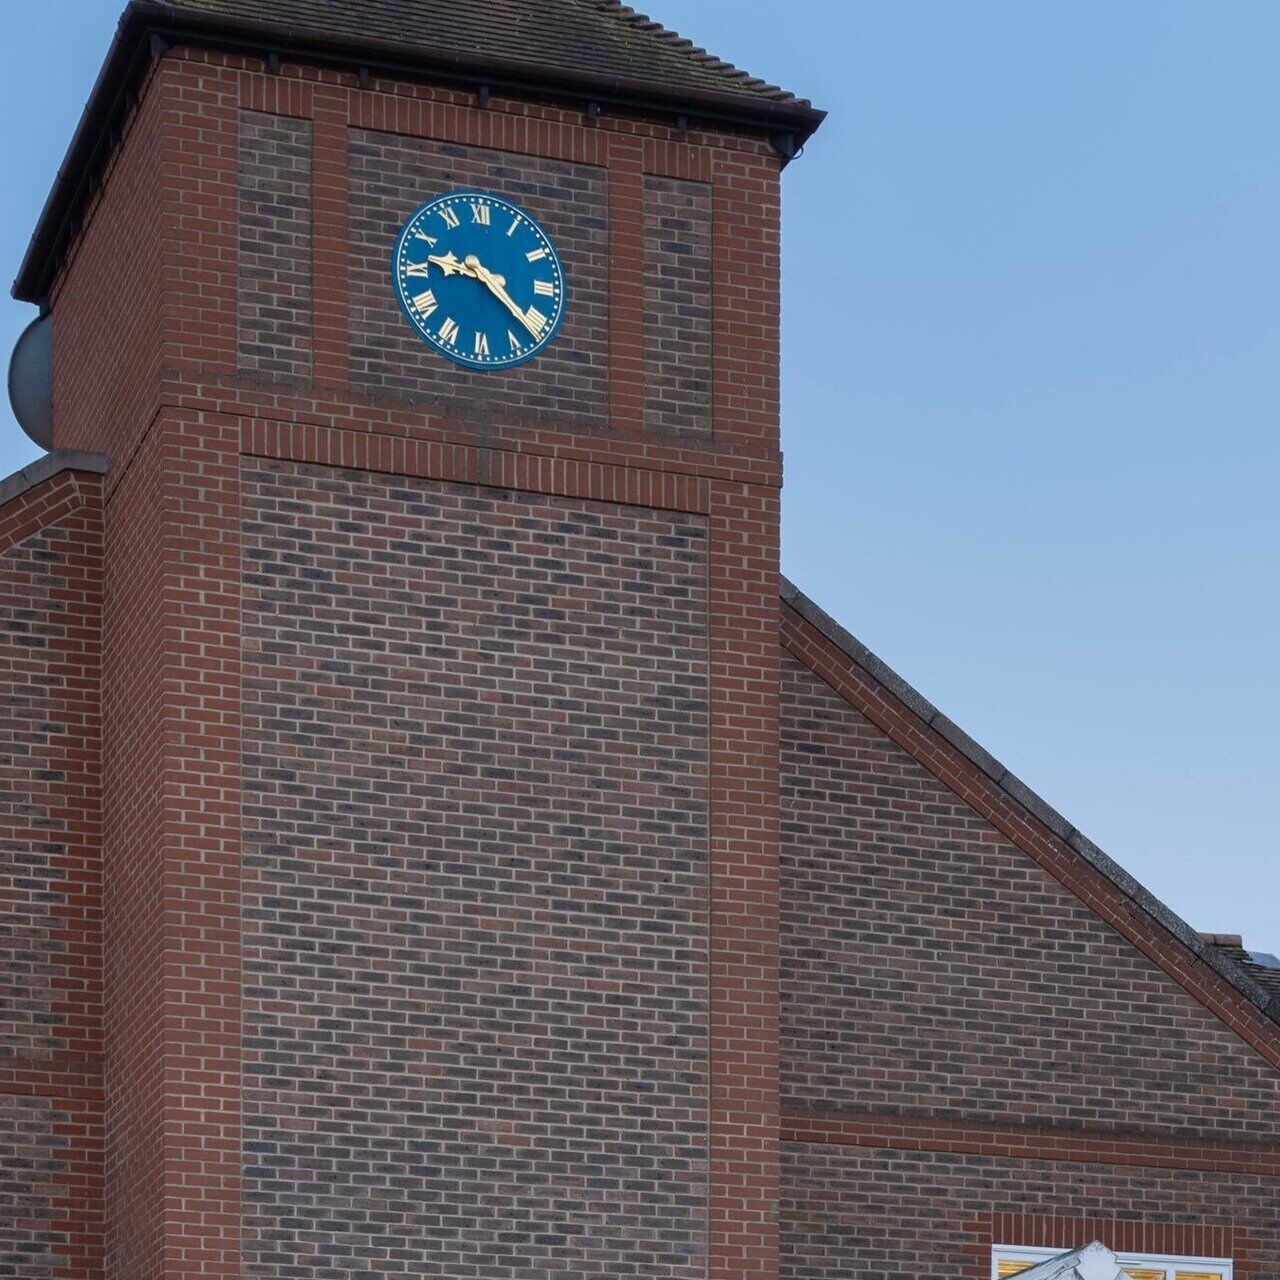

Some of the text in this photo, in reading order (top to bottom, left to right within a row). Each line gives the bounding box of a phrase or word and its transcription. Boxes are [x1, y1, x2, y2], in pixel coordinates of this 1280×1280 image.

[438, 206, 461, 230] XI
[470, 203, 491, 226] XII
[414, 228, 438, 248] X
[506, 219, 520, 237] I
[525, 247, 546, 263] II
[406, 259, 428, 279] IX
[534, 279, 554, 297] III
[412, 288, 439, 320] VIII
[438, 317, 460, 345] VII
[507, 329, 521, 351] V
[474, 331, 490, 355] VI
